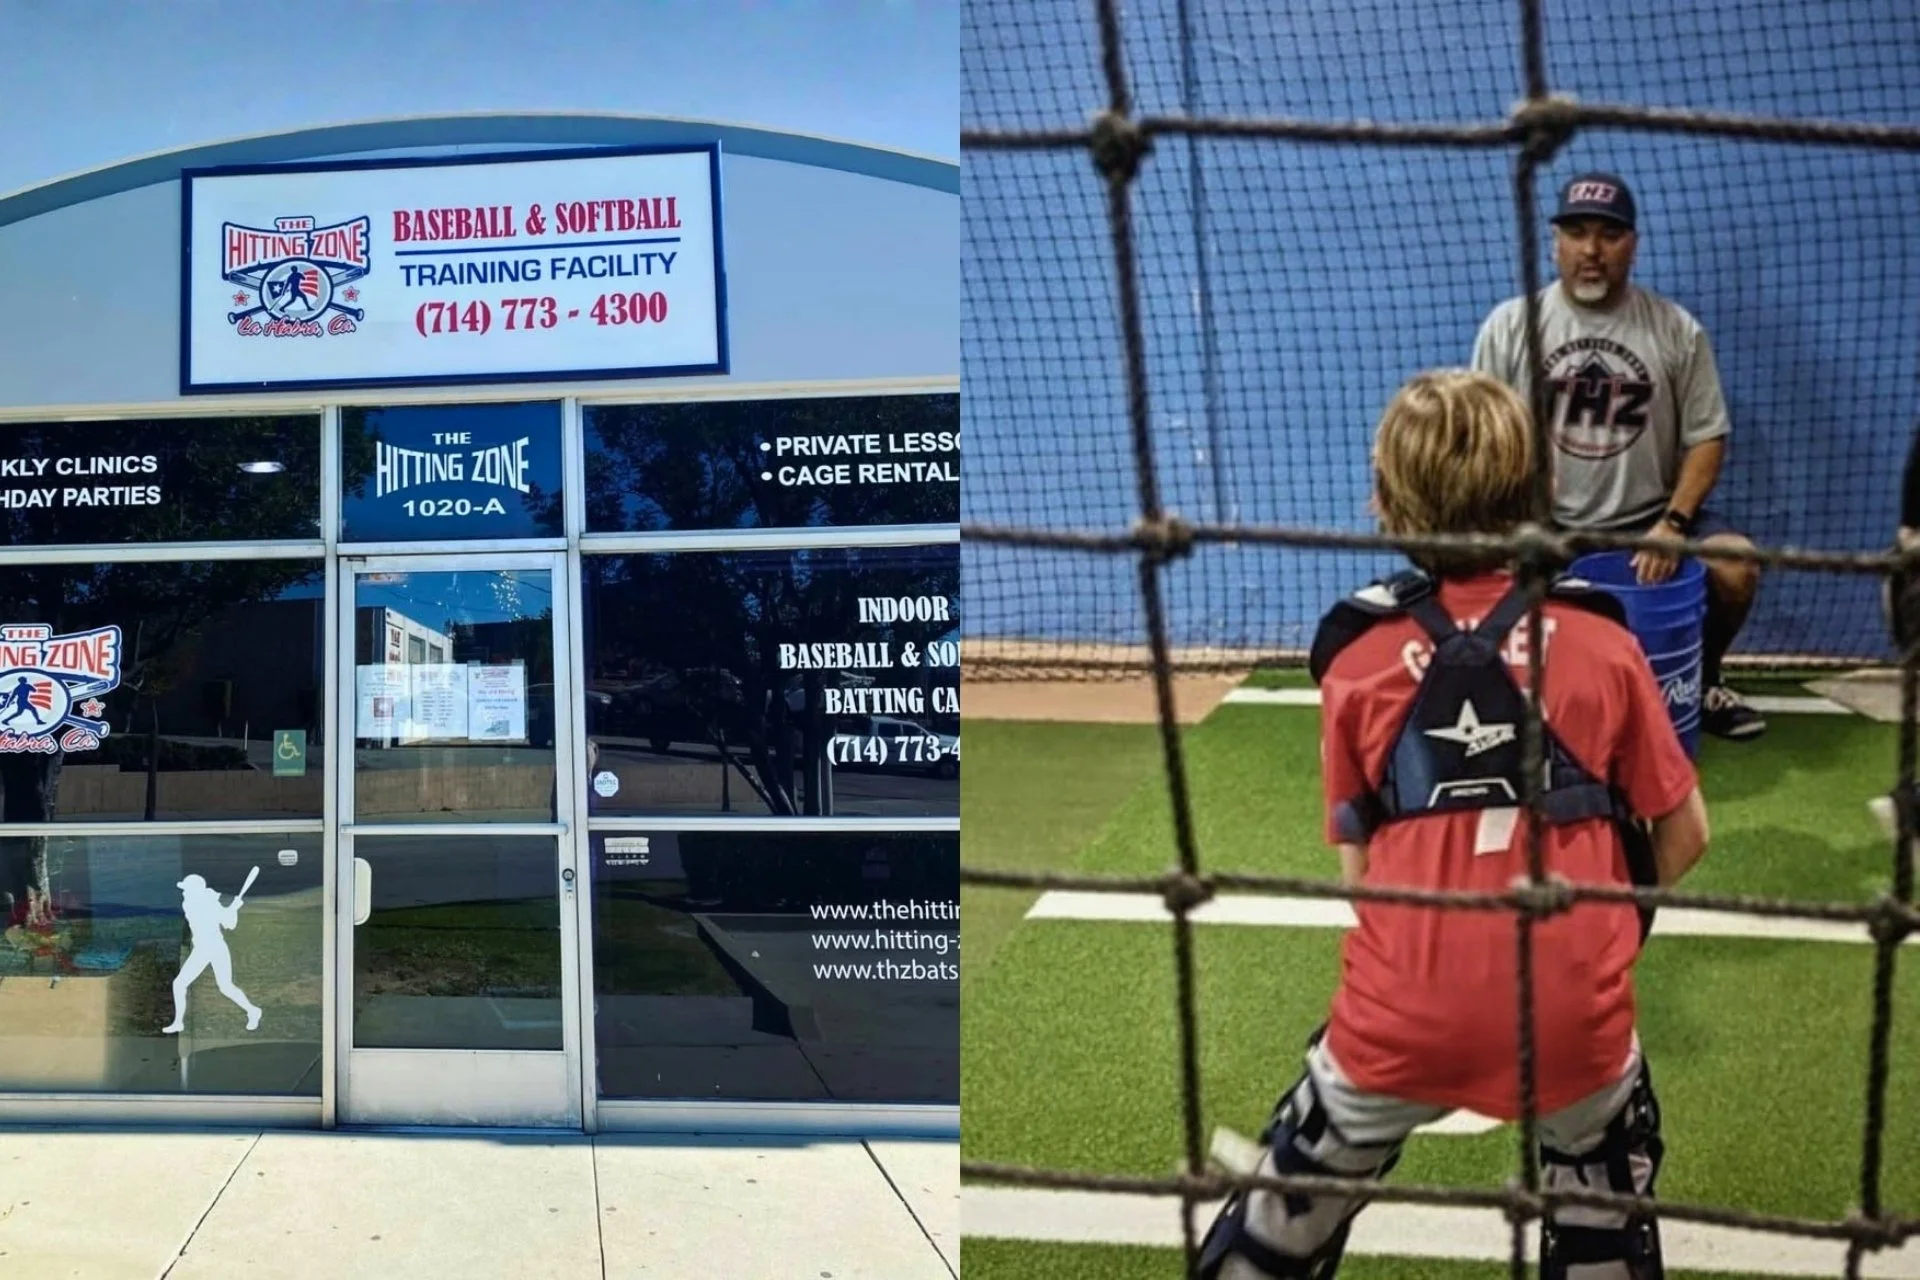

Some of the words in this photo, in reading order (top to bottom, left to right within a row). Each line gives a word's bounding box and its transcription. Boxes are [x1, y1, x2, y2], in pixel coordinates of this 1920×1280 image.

[278, 220, 312, 229] THE
[393, 206, 517, 241] BASEBALL
[525, 204, 547, 235] &
[555, 196, 681, 234] SOFTBALL
[229, 227, 305, 269] HITTING
[312, 223, 363, 263] ZONE
[399, 259, 541, 287] TRAINING
[550, 252, 677, 280] FACILITY
[238, 316, 261, 336] La
[264, 315, 323, 337] Habra,
[415, 300, 491, 337] (714)
[501, 297, 558, 330] 773
[568, 309, 580, 318] -
[590, 292, 667, 325] 4300
[432, 432, 472, 445] THE
[776, 434, 881, 456] PRIVATE
[889, 431, 960, 453] LESS
[1, 458, 50, 477] KLY
[55, 455, 158, 475] CLINICS
[376, 440, 464, 498] HITTING
[471, 437, 530, 494] ZONE
[778, 465, 851, 486] CAGE
[858, 461, 960, 484] RENTAL
[63, 486, 161, 507] PARTIES
[402, 497, 506, 517] 1020-A
[858, 595, 950, 623] INDOOR
[7, 629, 46, 639] THE
[0, 644, 37, 667] NG
[47, 633, 112, 677] ZONE
[779, 642, 894, 669] BASEBALL
[901, 641, 921, 667] &
[824, 687, 924, 714] BATTING
[932, 687, 960, 713] CA
[826, 736, 888, 766] (714)
[812, 929, 960, 955] www.hitting-
